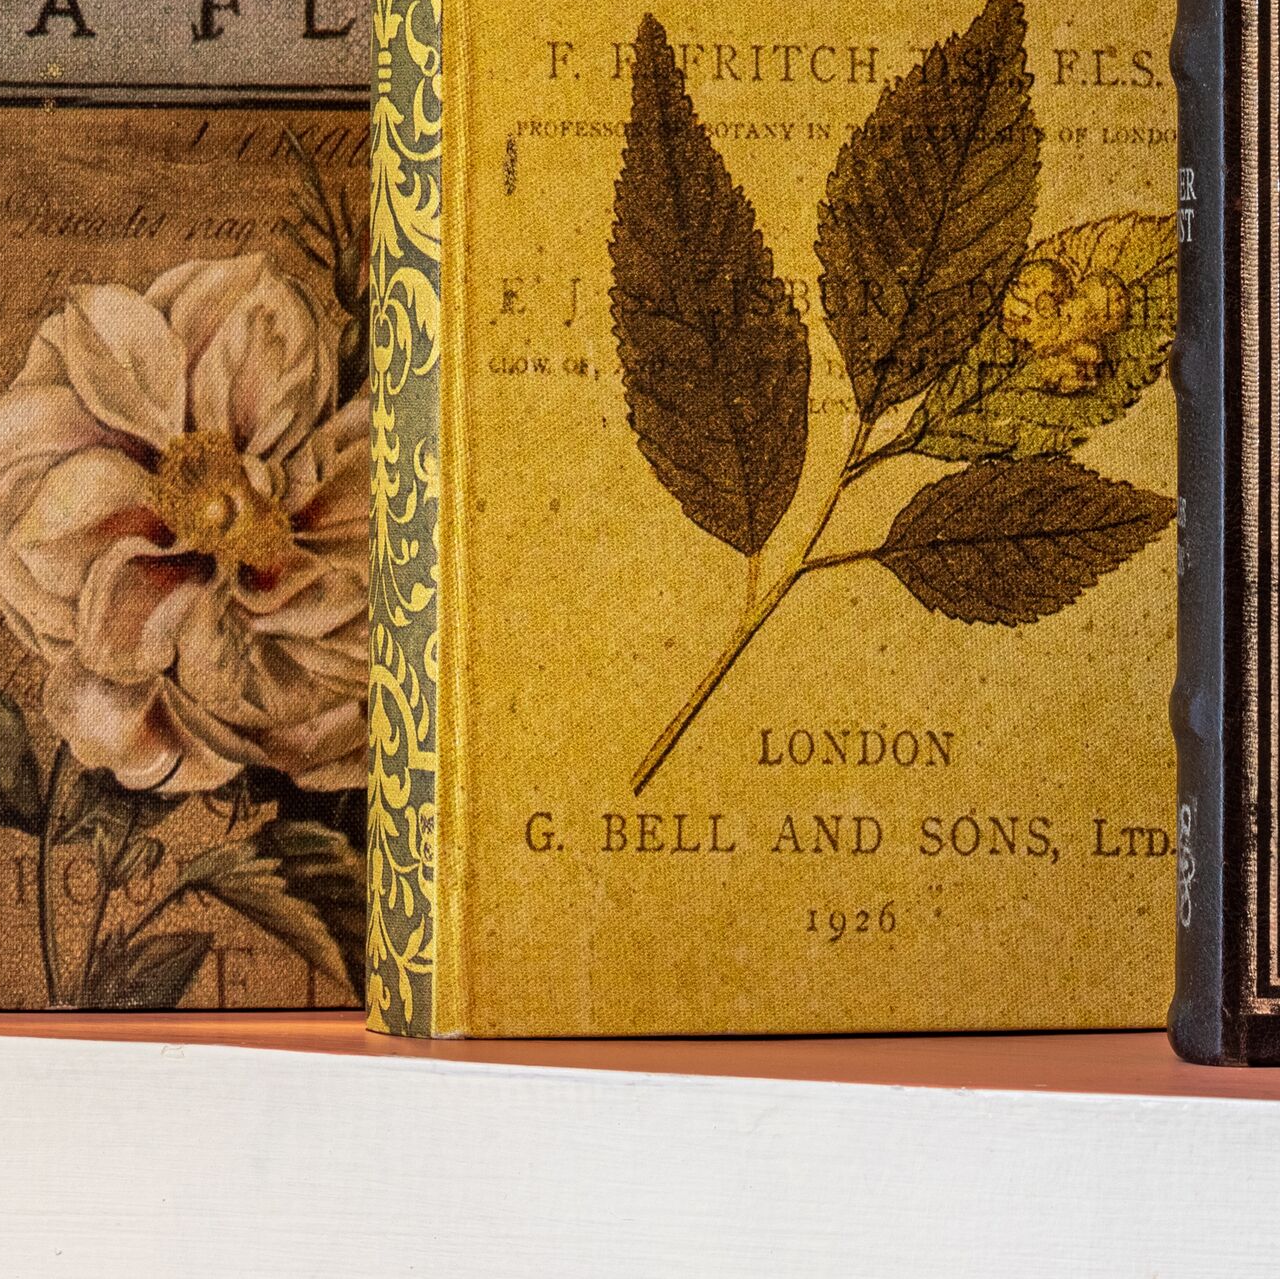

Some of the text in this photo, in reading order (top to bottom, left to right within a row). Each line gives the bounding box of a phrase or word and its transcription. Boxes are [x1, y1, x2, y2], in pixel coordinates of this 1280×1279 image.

[1053, 47, 1164, 89] F.L.S.
[517, 120, 633, 139] PROFESSO
[807, 123, 831, 140] IN
[1059, 126, 1088, 144] OF
[758, 729, 955, 768] LONDON
[525, 812, 564, 854] G.
[601, 813, 736, 854] BELL
[772, 814, 883, 855] AND
[920, 816, 1061, 865] SONS,
[806, 900, 898, 942] 1926
